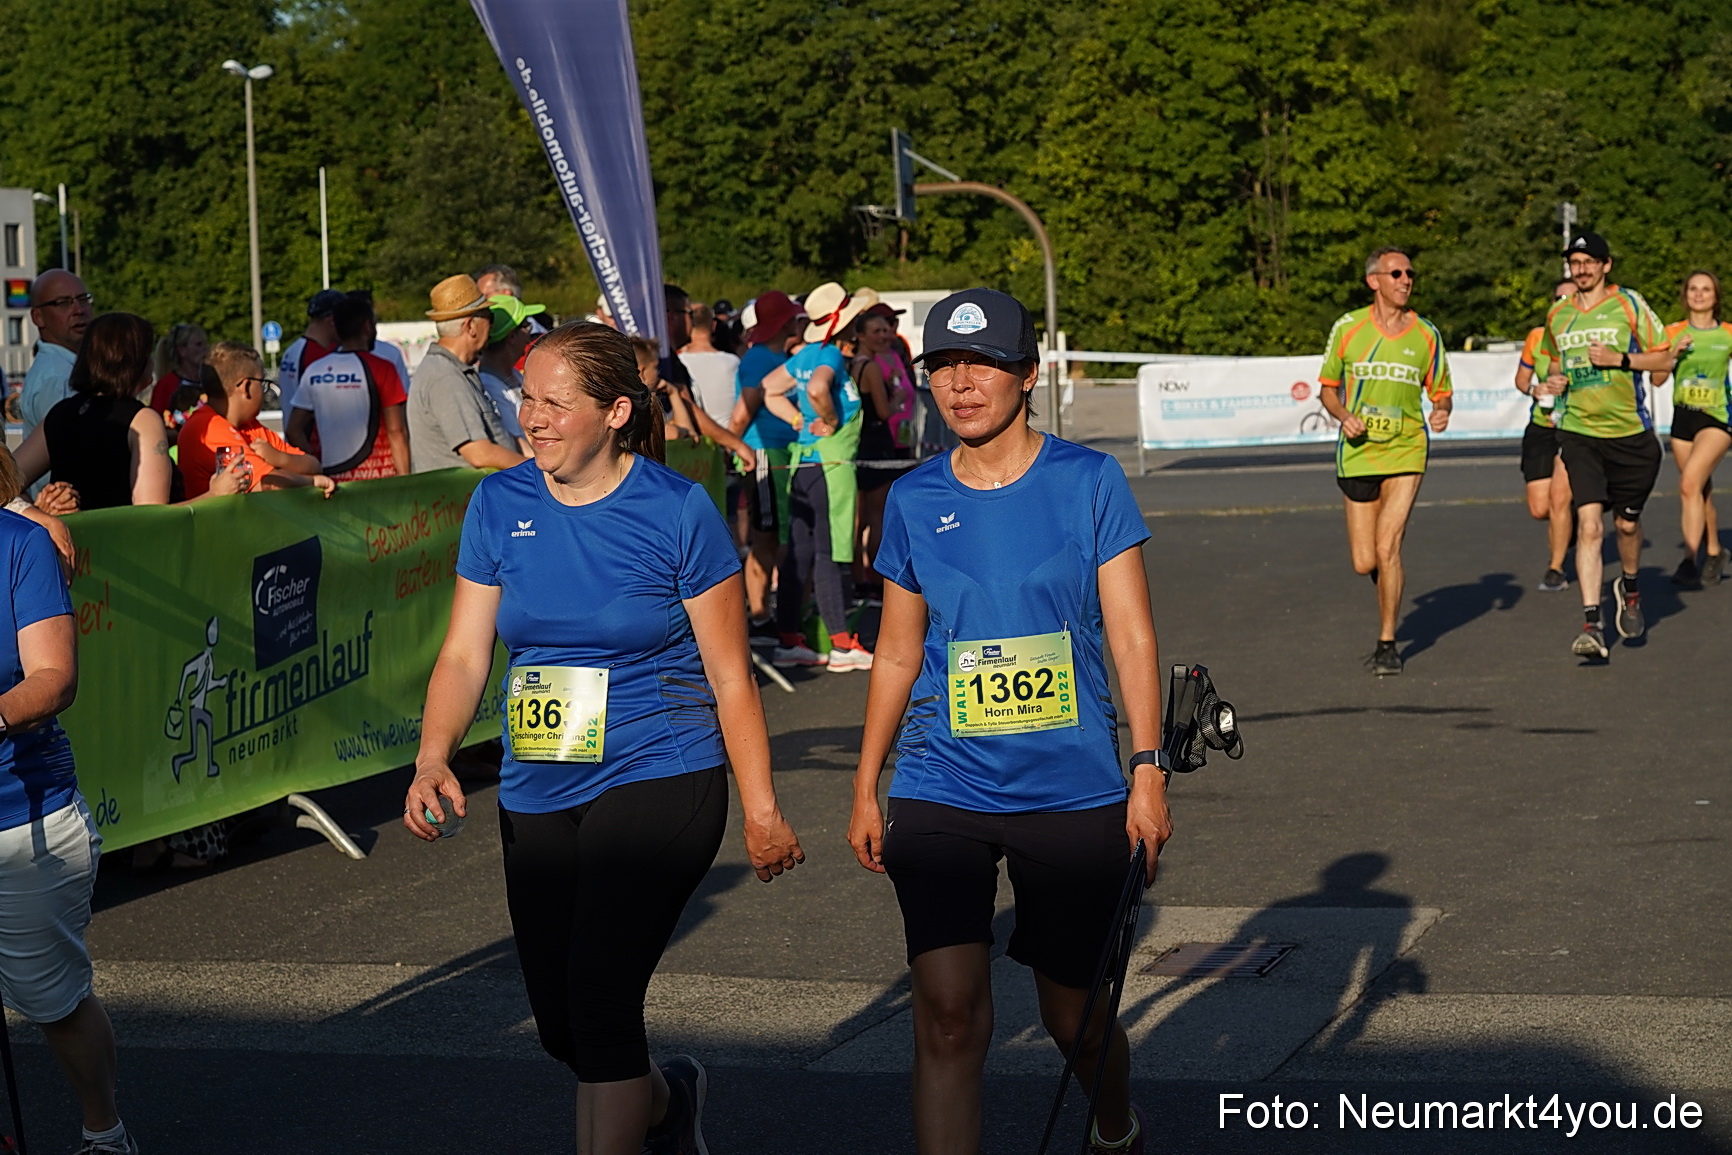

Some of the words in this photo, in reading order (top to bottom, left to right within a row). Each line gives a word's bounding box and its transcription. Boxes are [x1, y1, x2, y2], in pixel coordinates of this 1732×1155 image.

[1555, 328, 1619, 352] BOCK
[1352, 361, 1421, 387] BOCK
[1366, 417, 1391, 431] 612
[365, 501, 431, 563] Gesunde
[936, 521, 960, 534] erima
[395, 551, 442, 600] laufen
[267, 577, 311, 608] Fischer
[226, 610, 373, 736] firmenlauf
[977, 654, 1017, 666] Firmenlauf
[522, 682, 552, 691] Firmenlauf
[955, 679, 967, 724] WALK
[969, 668, 1055, 704] 1362
[1057, 670, 1071, 713] 2022
[984, 706, 1013, 718] Horn
[1017, 704, 1043, 715] Mira
[228, 714, 298, 766] neumarkt
[586, 716, 599, 749] 202
